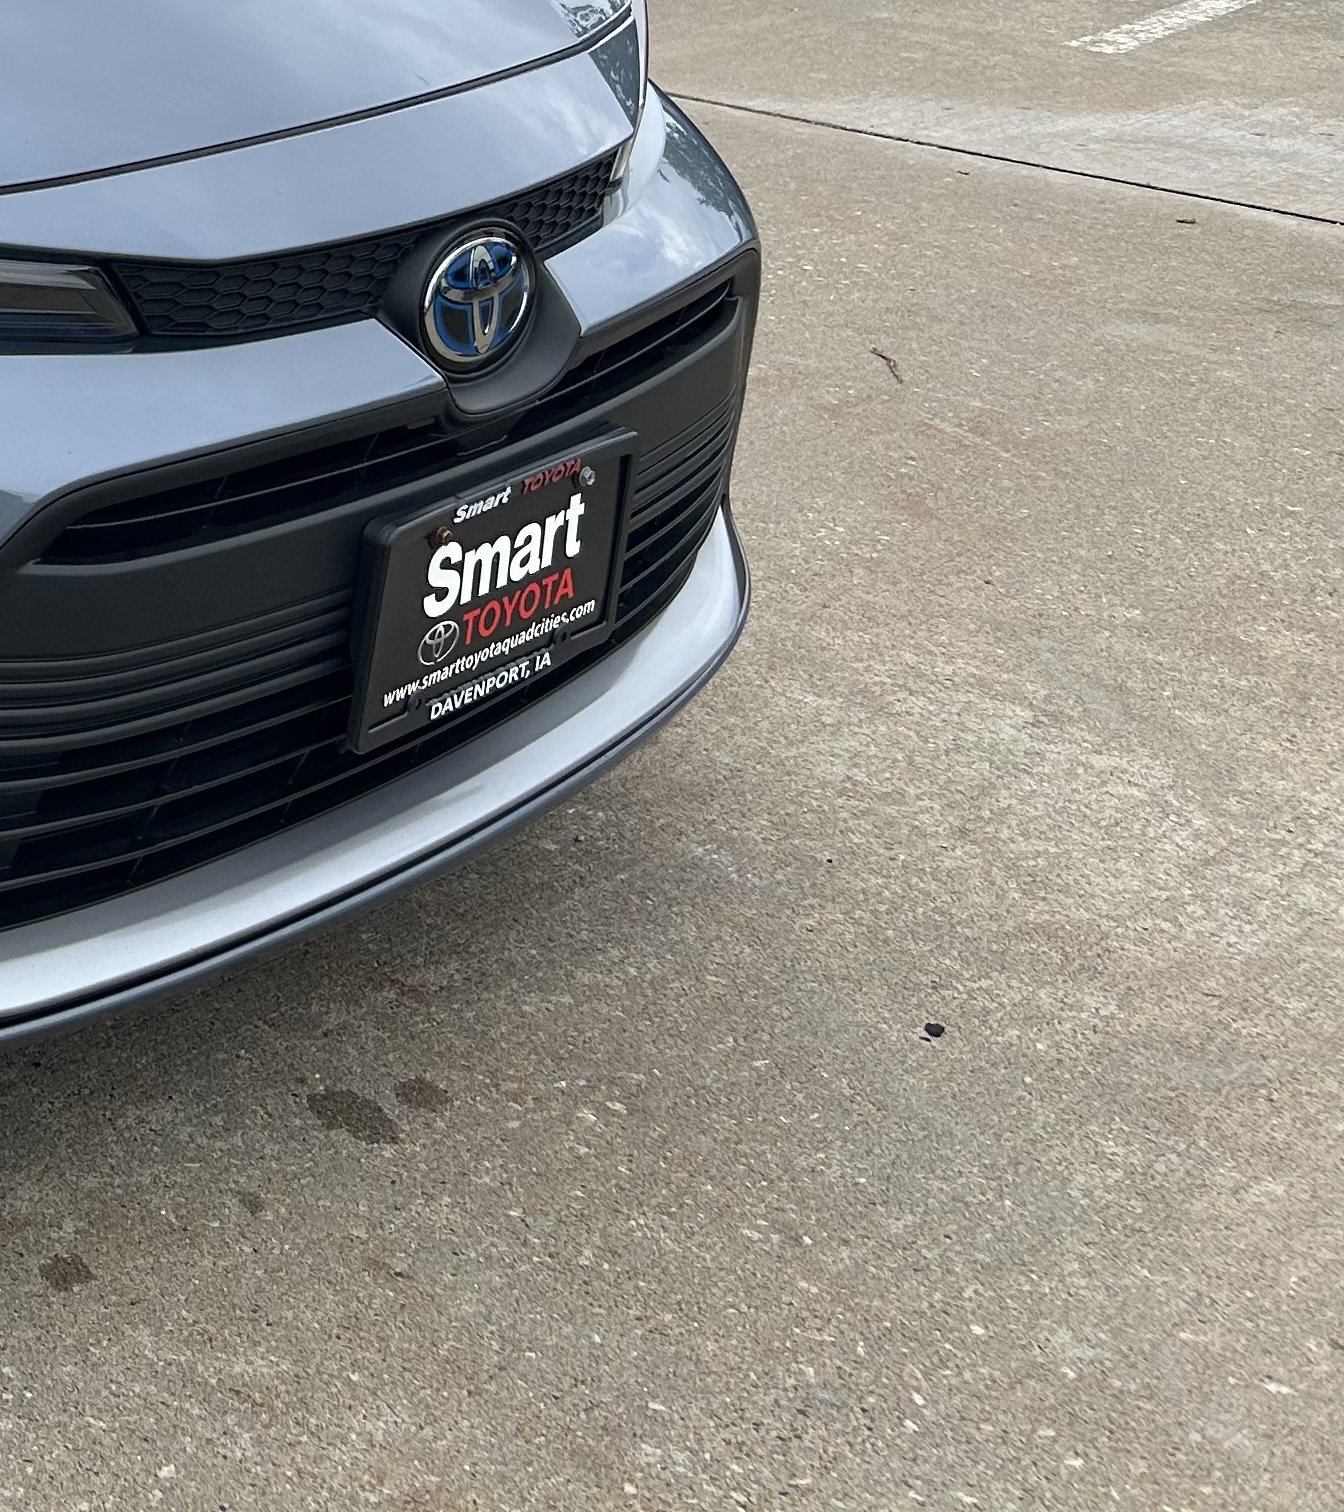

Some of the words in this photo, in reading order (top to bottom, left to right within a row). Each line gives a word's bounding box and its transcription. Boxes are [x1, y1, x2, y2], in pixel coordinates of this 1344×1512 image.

[453, 486, 512, 524] Smart
[520, 458, 581, 496] TOYOTA
[423, 493, 586, 618] Smart
[462, 568, 574, 646] TOYOTA
[430, 660, 530, 720] DAVENPORT,
[534, 651, 552, 672] IA
